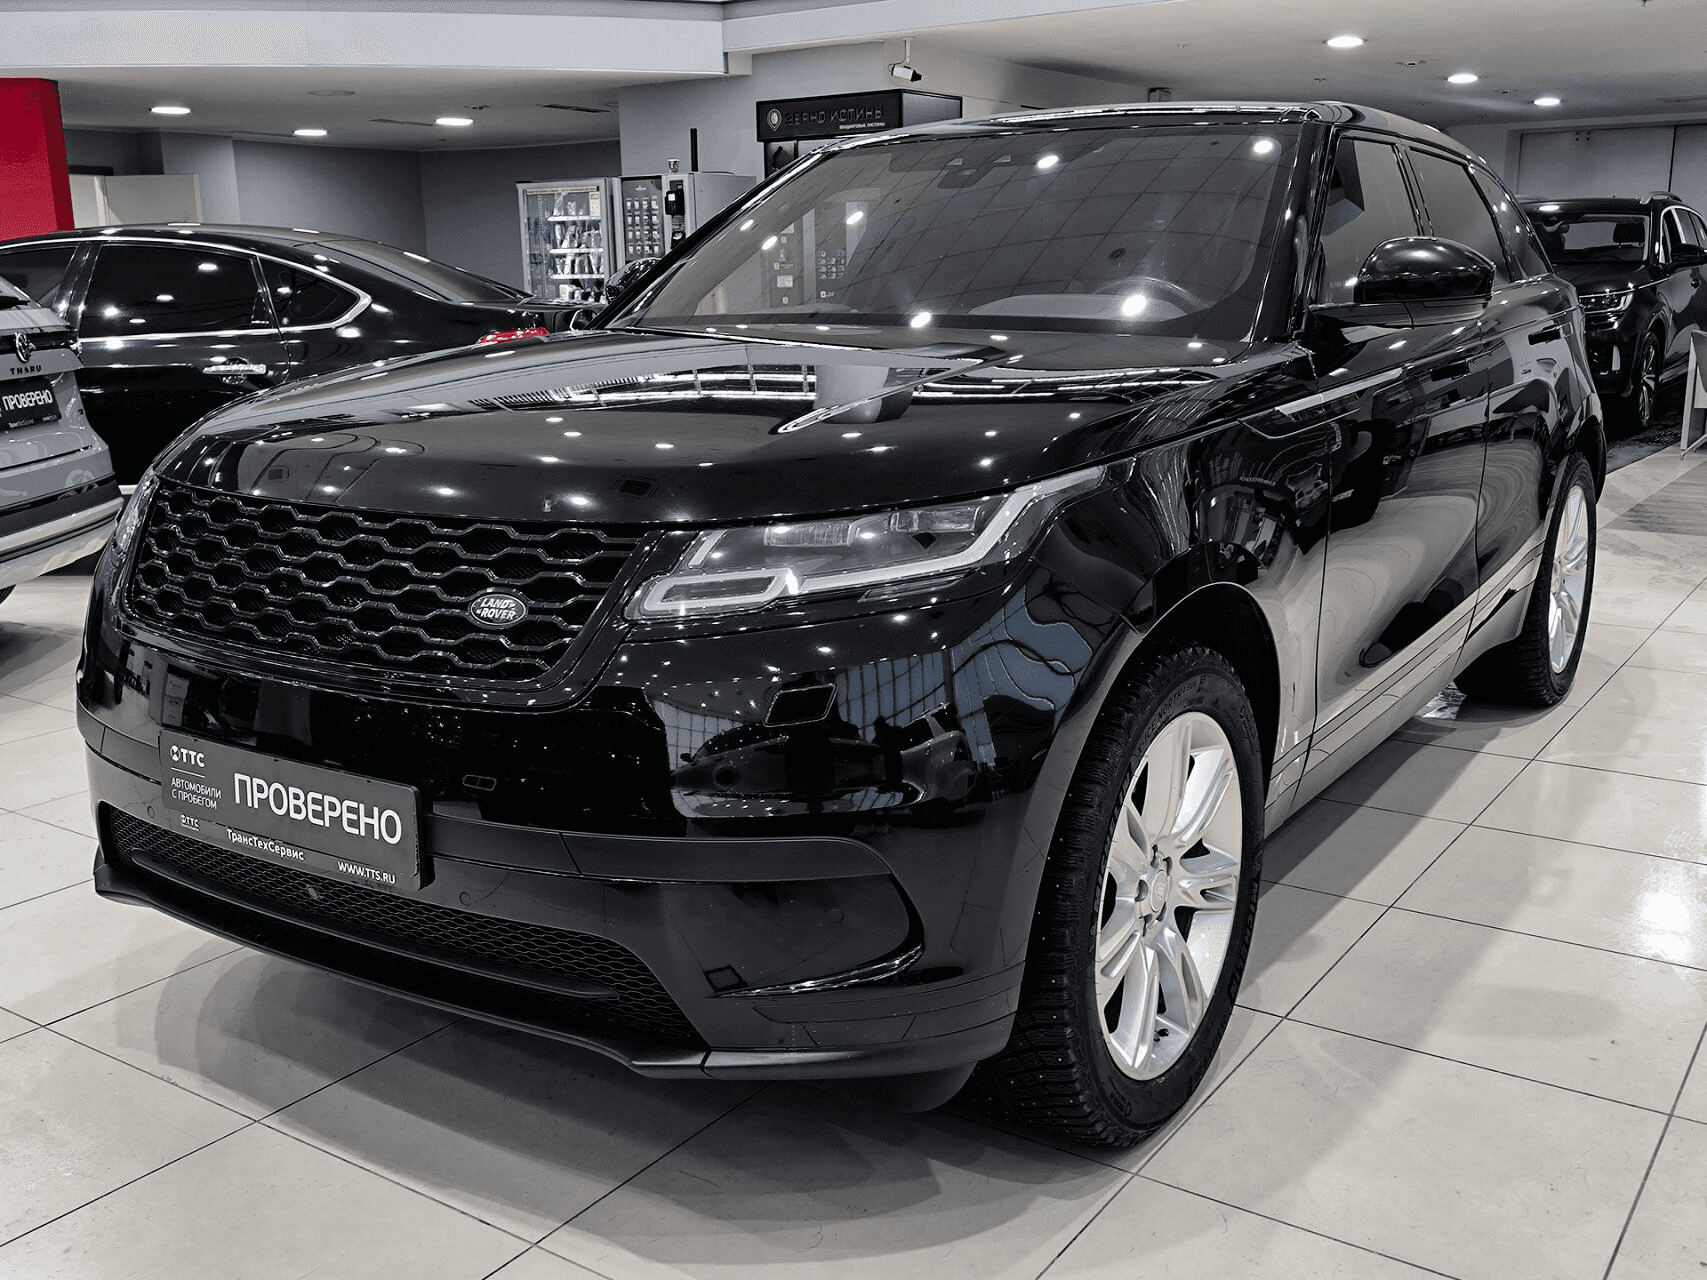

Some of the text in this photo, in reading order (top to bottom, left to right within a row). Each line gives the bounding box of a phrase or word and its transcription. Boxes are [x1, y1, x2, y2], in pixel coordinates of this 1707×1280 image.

[784, 105, 885, 126] ЗЕРНО ИСТИНЫ
[10, 365, 42, 375] THARU
[2, 389, 53, 411] ПРОВЕРЕНО
[480, 598, 515, 609] LAND
[480, 608, 516, 620] ROVER
[171, 777, 222, 800] АВТОМОБИЛИ
[171, 788, 218, 810] С ПРОБЕГОМ
[233, 772, 402, 845] ПРОВЕРЕНО
[226, 828, 306, 861] ТрансТехСервис
[337, 860, 397, 885] WWW.TTS.RU
